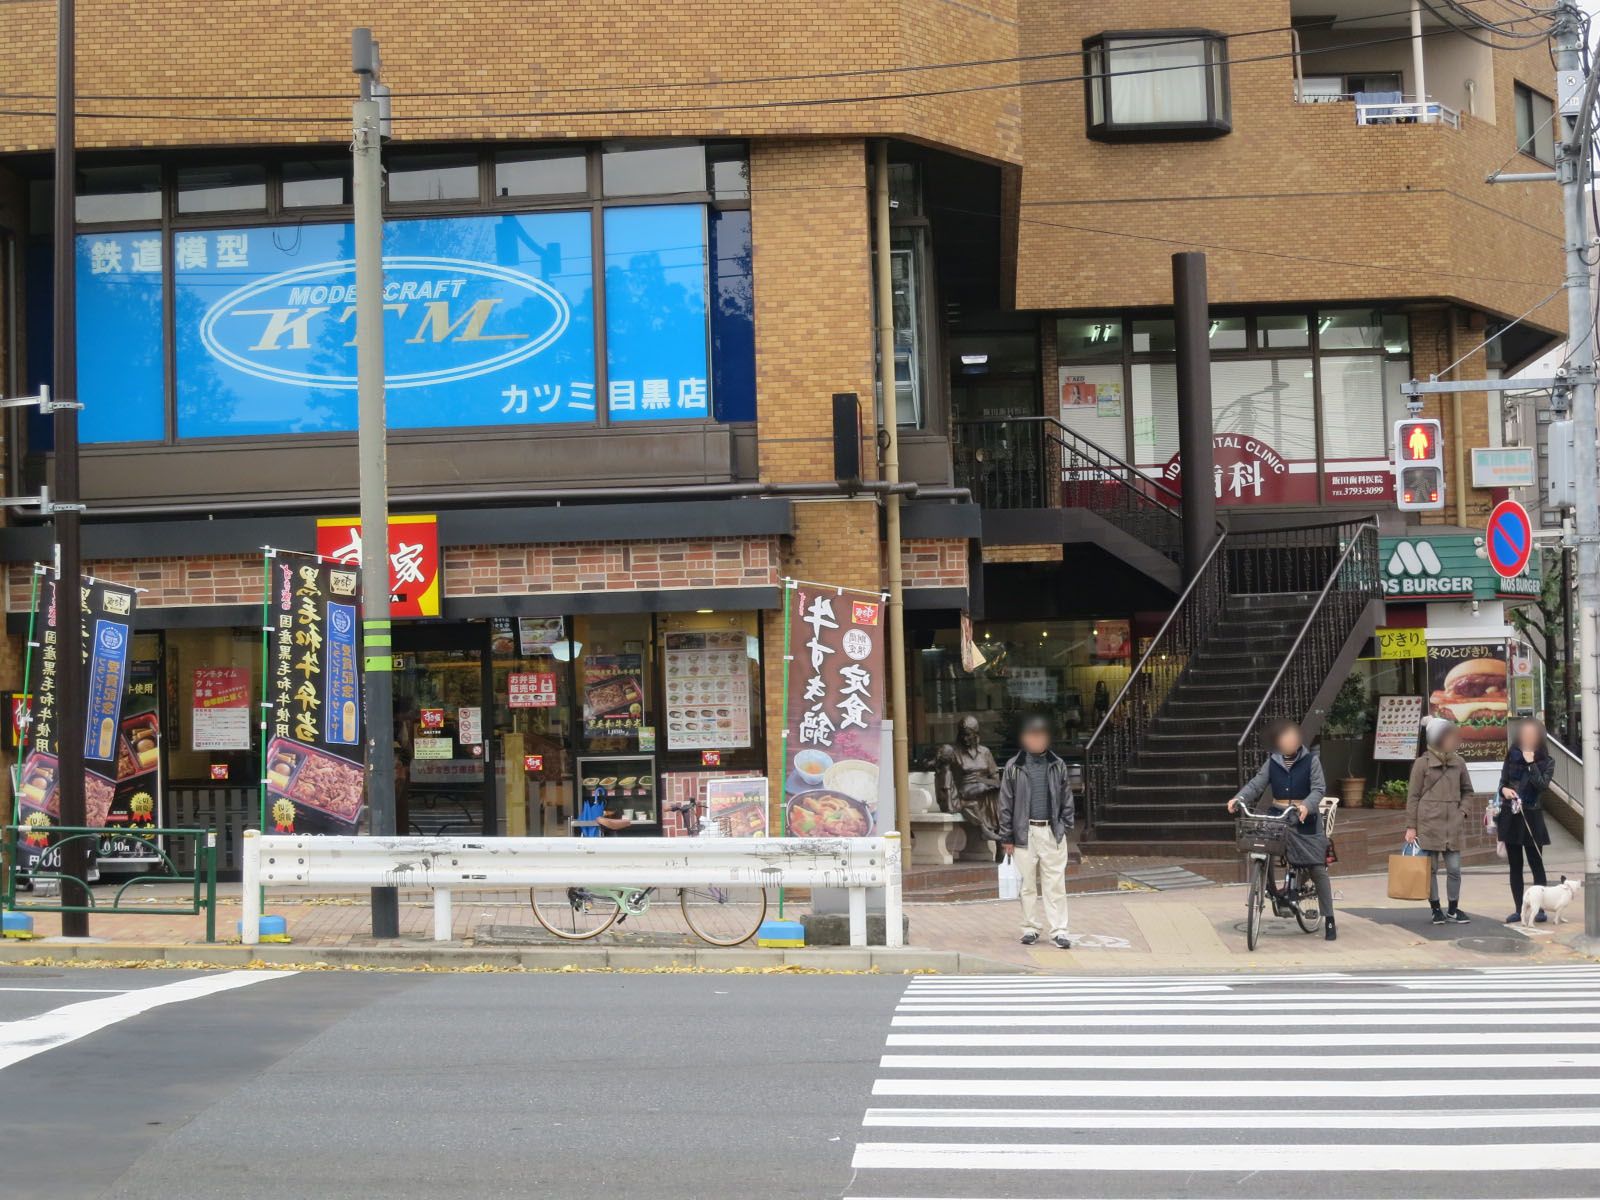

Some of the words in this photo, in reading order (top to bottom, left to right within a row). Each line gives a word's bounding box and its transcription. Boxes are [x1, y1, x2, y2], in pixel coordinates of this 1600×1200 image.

[92, 234, 249, 275] 鉄道模型
[288, 286, 357, 305] MODE
[384, 279, 467, 300] CRAFT
[502, 376, 707, 415] カツミ目黒店
[1165, 455, 1181, 481] IID
[1213, 437, 1241, 449] TAL
[1245, 441, 1285, 474] CLINIC
[1343, 486, 1384, 496] 3793-3099
[1403, 577, 1473, 592] BURGER
[1501, 578, 1515, 592] MOS
[1515, 578, 1541, 593] BURGER
[1429, 646, 1493, 659] 冬のとびきり。
